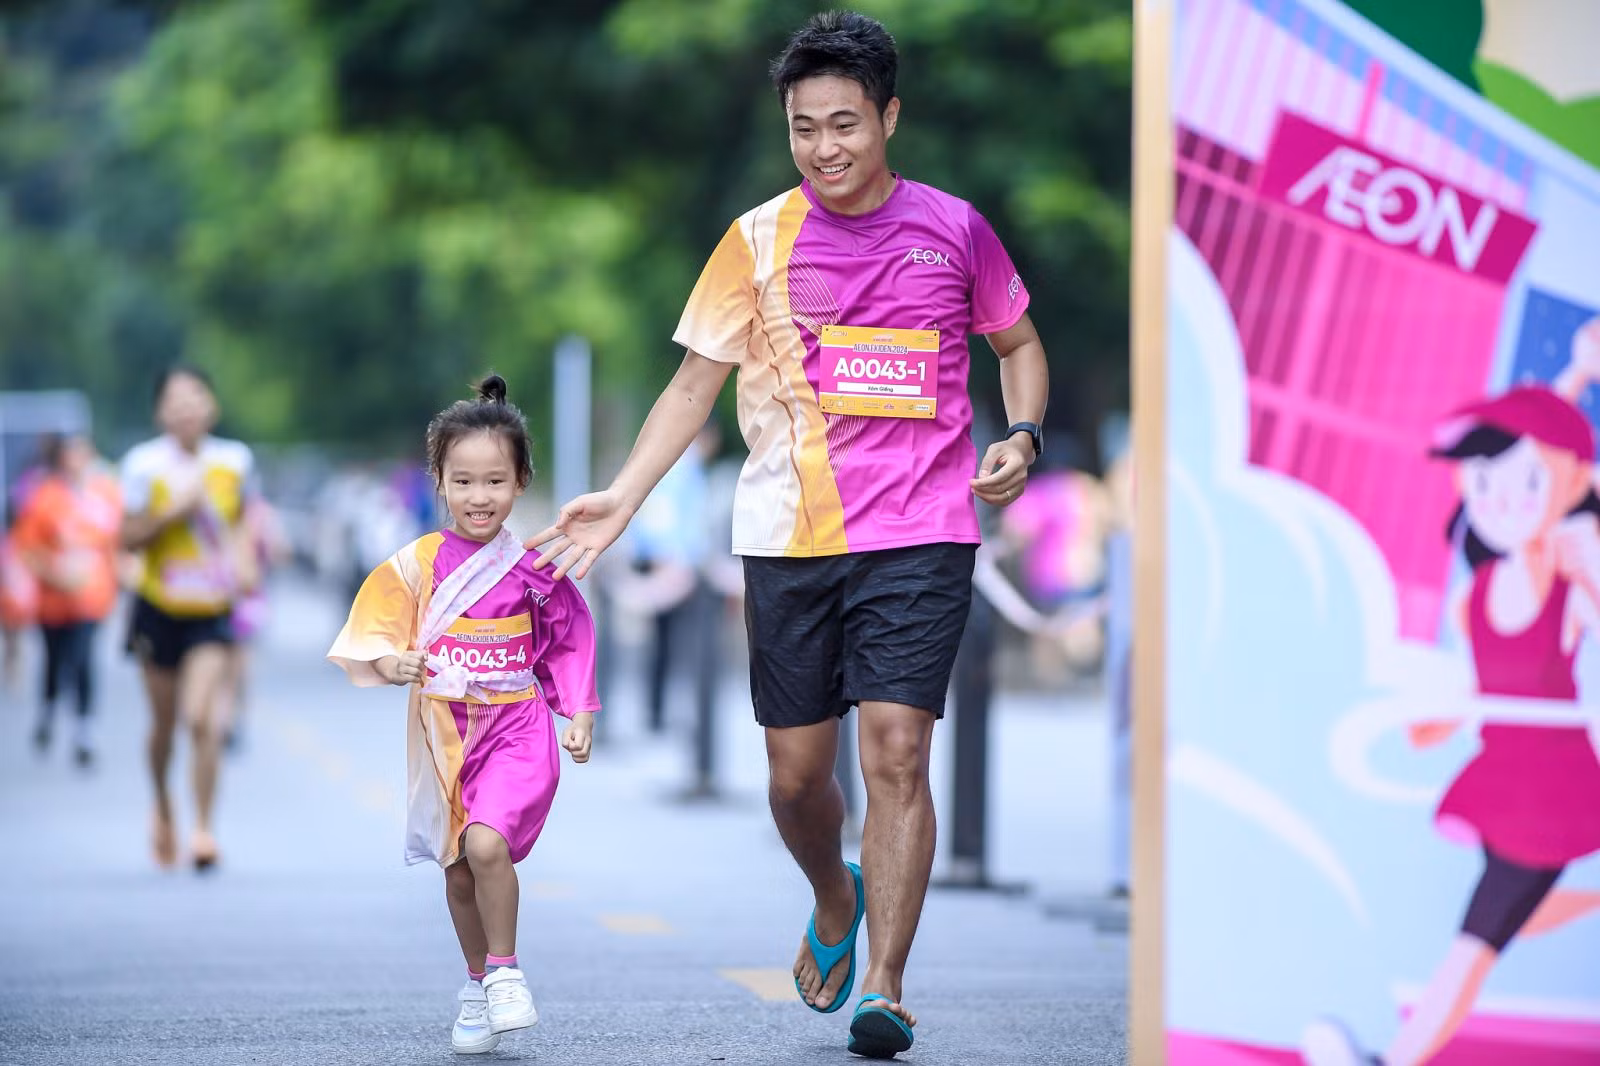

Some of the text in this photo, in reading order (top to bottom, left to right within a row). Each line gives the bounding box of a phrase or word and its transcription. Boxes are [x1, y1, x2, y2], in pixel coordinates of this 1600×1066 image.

[892, 345, 908, 354] 2024
[832, 357, 926, 381] A0043-1
[495, 634, 510, 643] 2024
[438, 644, 526, 668] A0043-4
